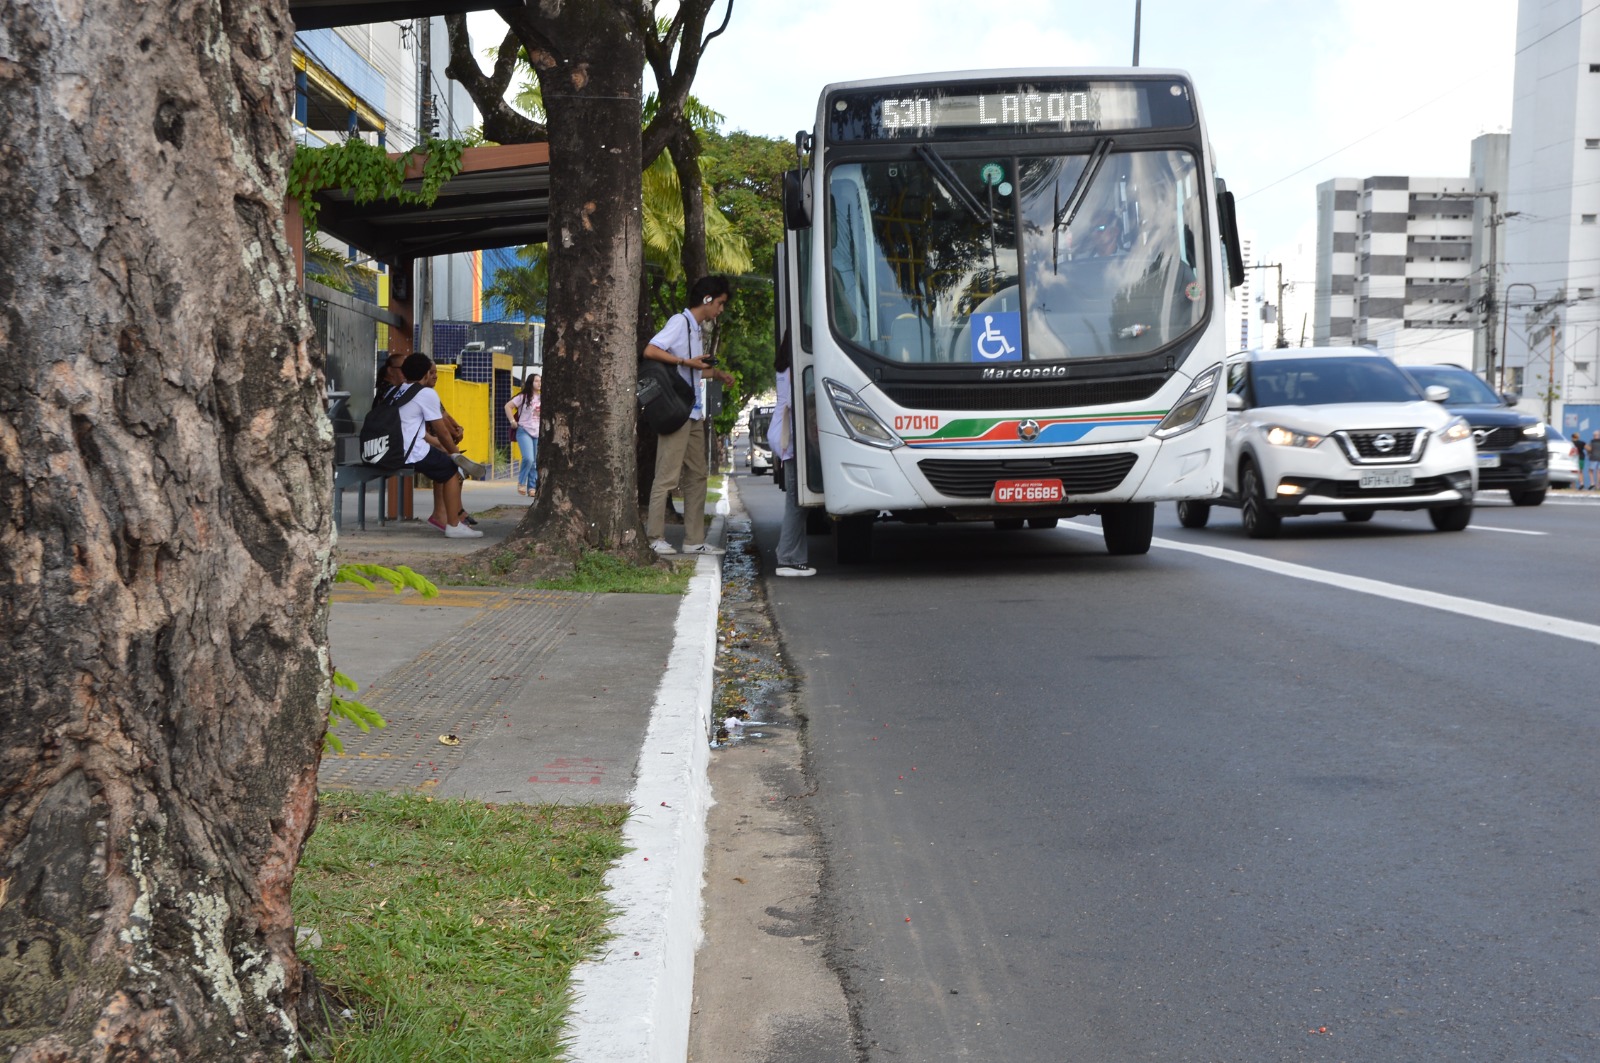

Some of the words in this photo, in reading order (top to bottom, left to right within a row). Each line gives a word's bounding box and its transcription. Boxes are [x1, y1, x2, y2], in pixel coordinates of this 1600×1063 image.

[884, 98, 931, 128] 530
[979, 92, 1087, 125] LAGOA
[982, 366, 1066, 379] Marcopolo
[894, 415, 939, 430] 07010
[363, 434, 390, 458] NIKE
